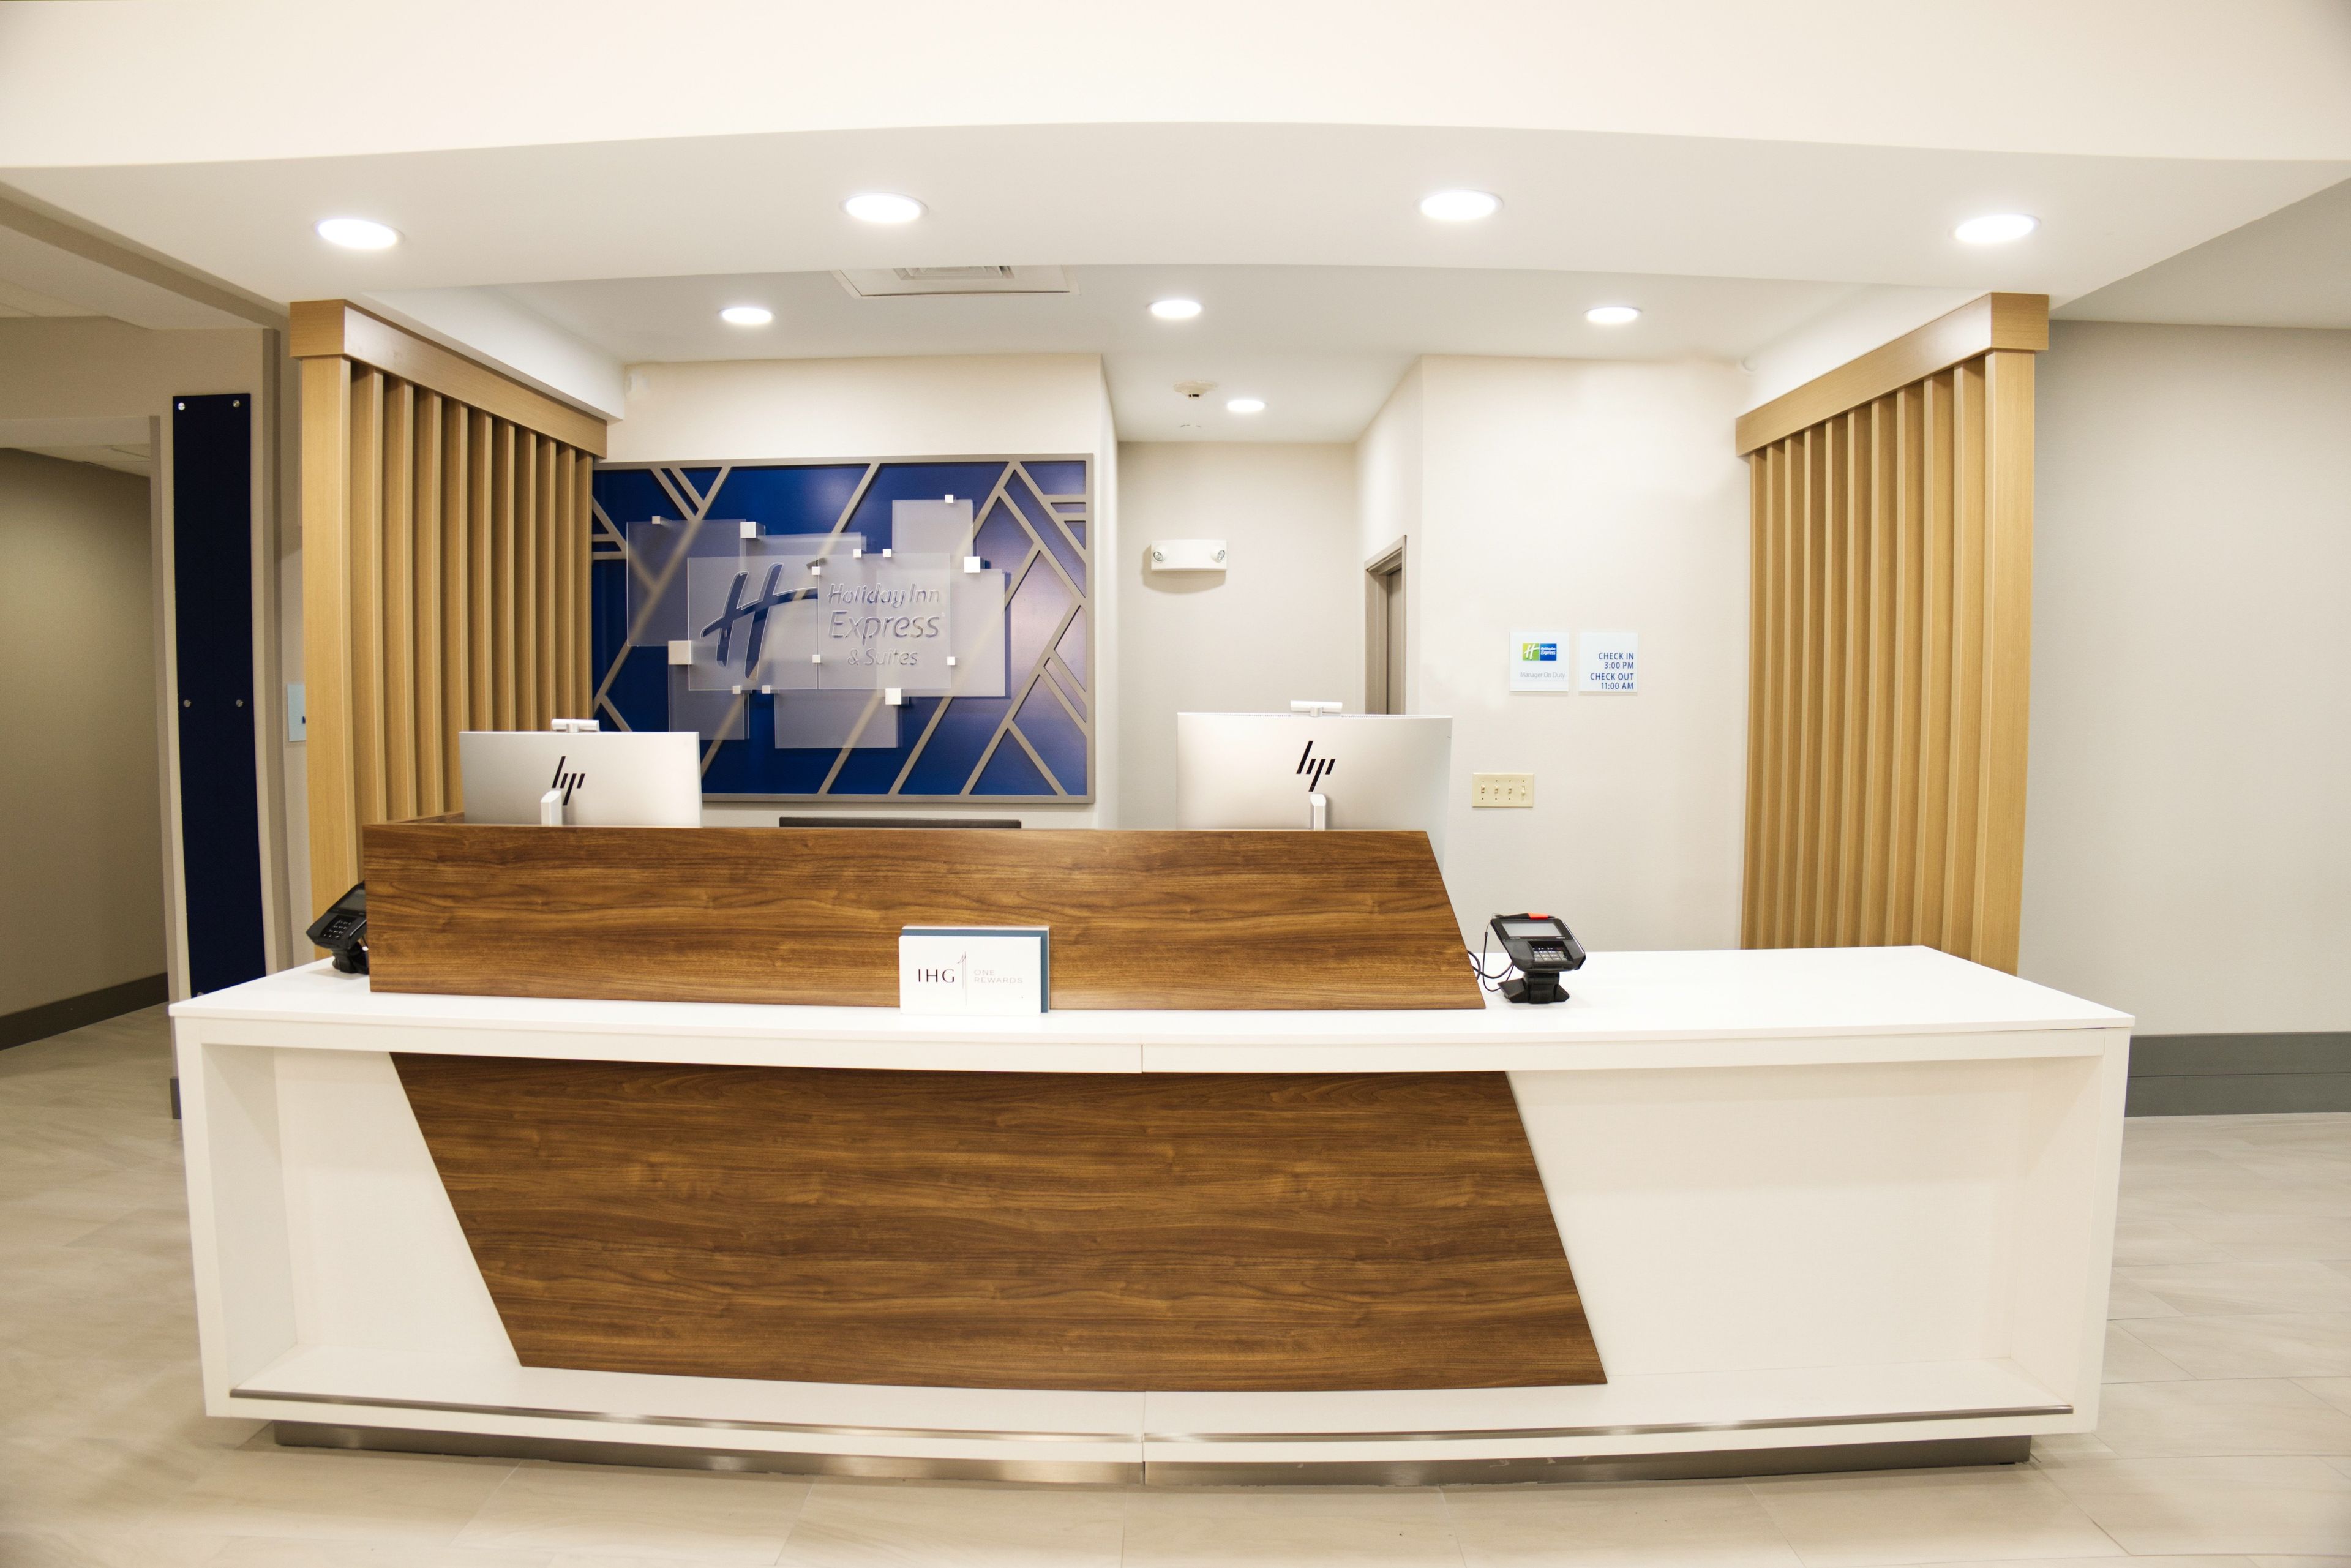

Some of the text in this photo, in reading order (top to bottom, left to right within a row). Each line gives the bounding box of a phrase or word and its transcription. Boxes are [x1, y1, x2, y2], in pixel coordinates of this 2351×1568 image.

[827, 583, 940, 608] Holiday Inn
[828, 610, 940, 646] Express
[847, 648, 918, 665] & Suites
[552, 756, 585, 806] hp
[1296, 740, 1336, 792] hp
[918, 969, 954, 983] IHG
